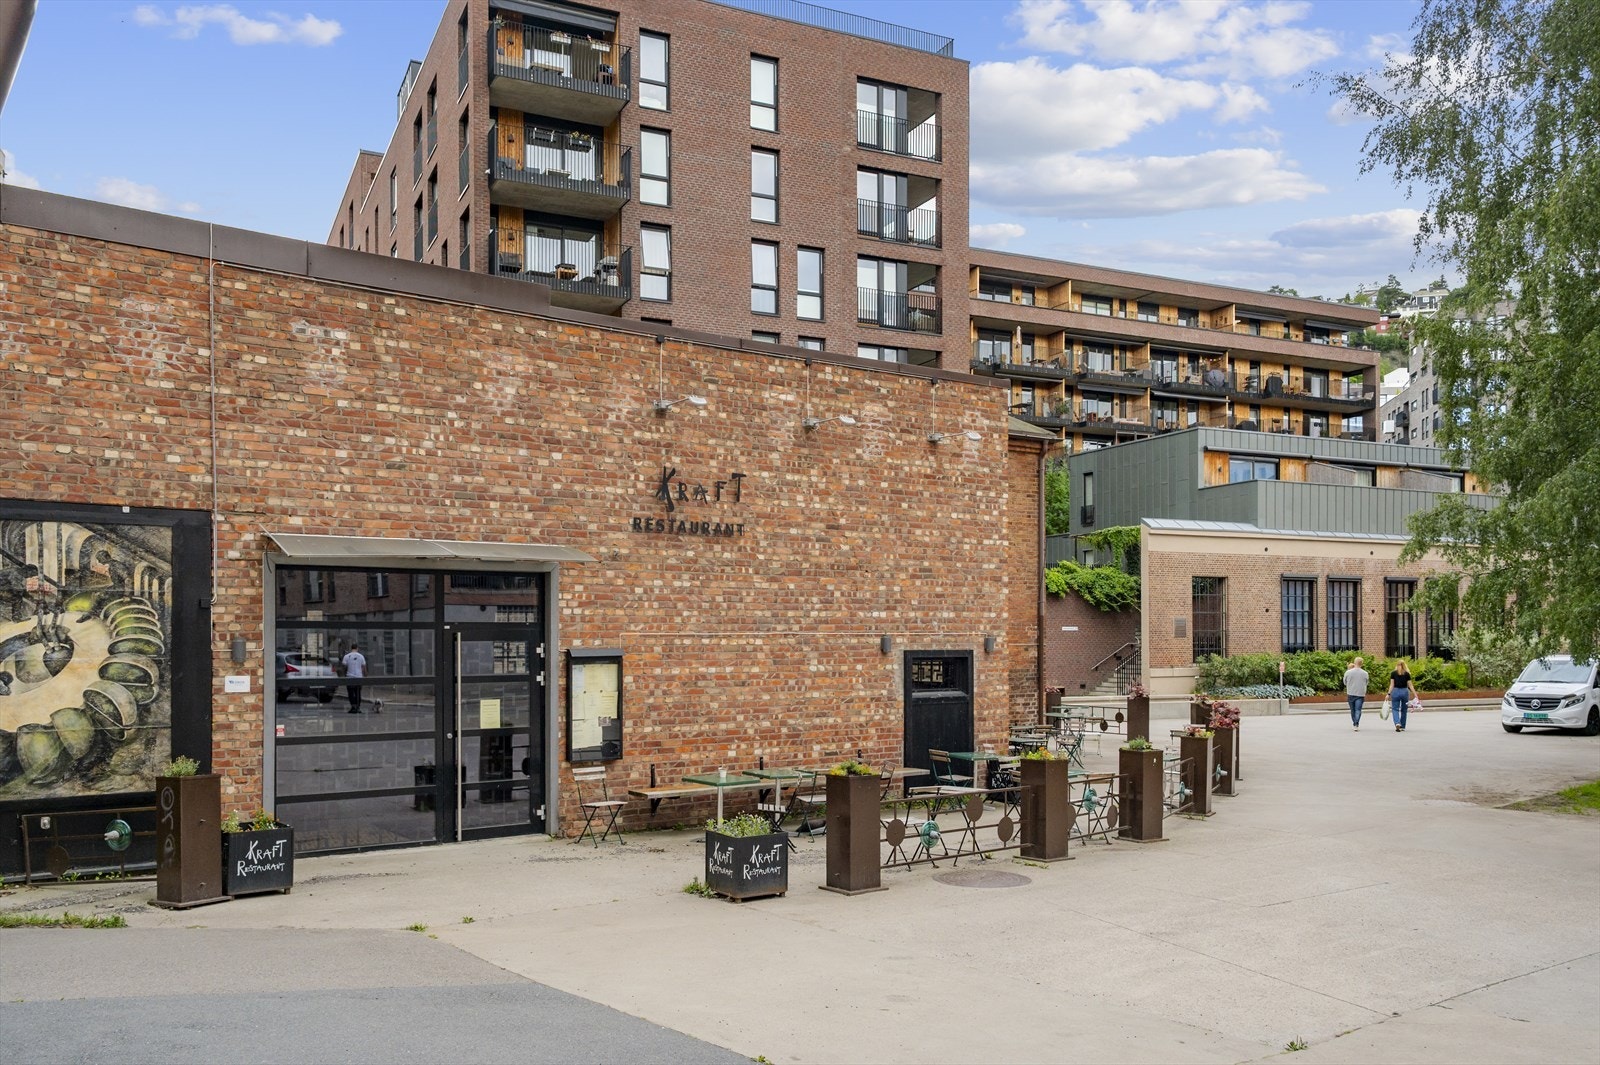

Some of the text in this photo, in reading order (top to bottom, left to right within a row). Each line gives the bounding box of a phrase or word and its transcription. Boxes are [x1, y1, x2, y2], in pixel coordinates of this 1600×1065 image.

[656, 465, 747, 512] KRAFT
[632, 517, 745, 537] RESTAURANT
[245, 839, 287, 864] KRAFT
[713, 841, 734, 865] KRAFT
[749, 844, 783, 868] KRAFT
